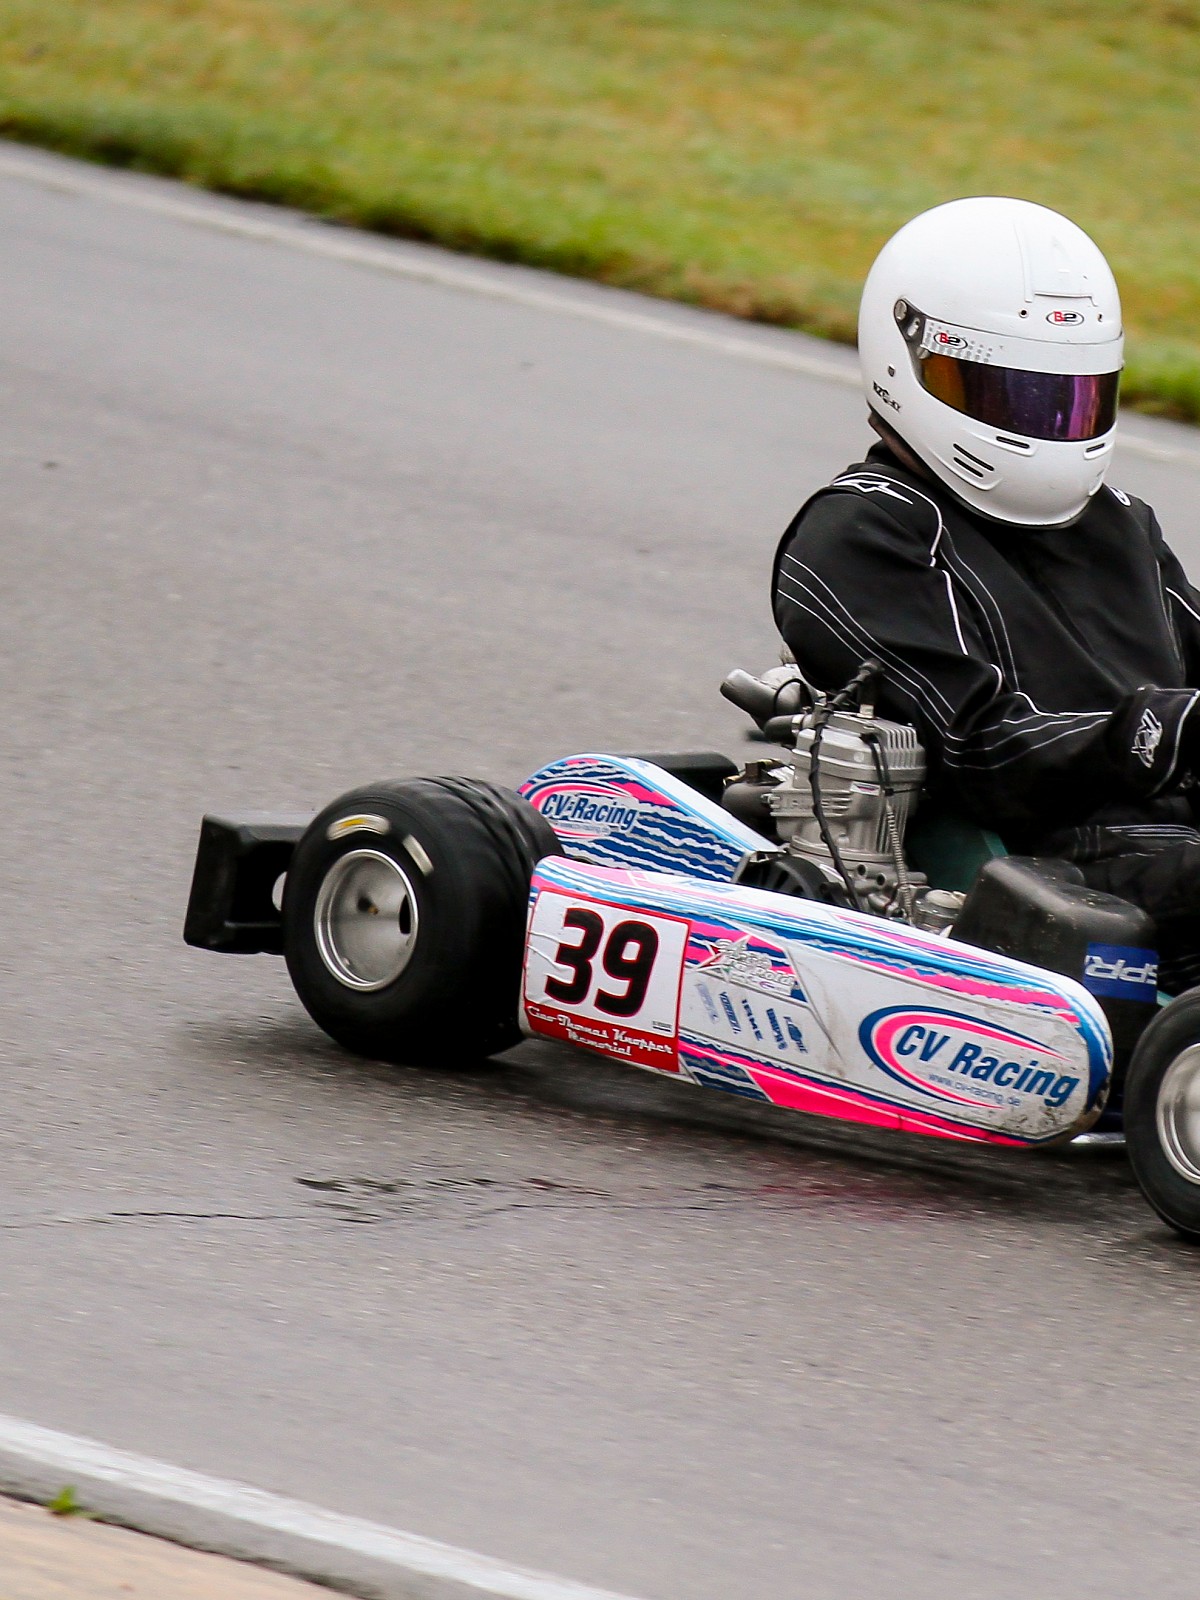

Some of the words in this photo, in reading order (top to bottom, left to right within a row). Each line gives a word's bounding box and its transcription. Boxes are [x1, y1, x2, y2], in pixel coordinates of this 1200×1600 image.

[543, 906, 661, 1018] 39
[556, 1013, 610, 1039] Thomas
[565, 1027, 632, 1057] Memorial
[895, 1024, 951, 1062] CV
[947, 1042, 1081, 1108] Racing
